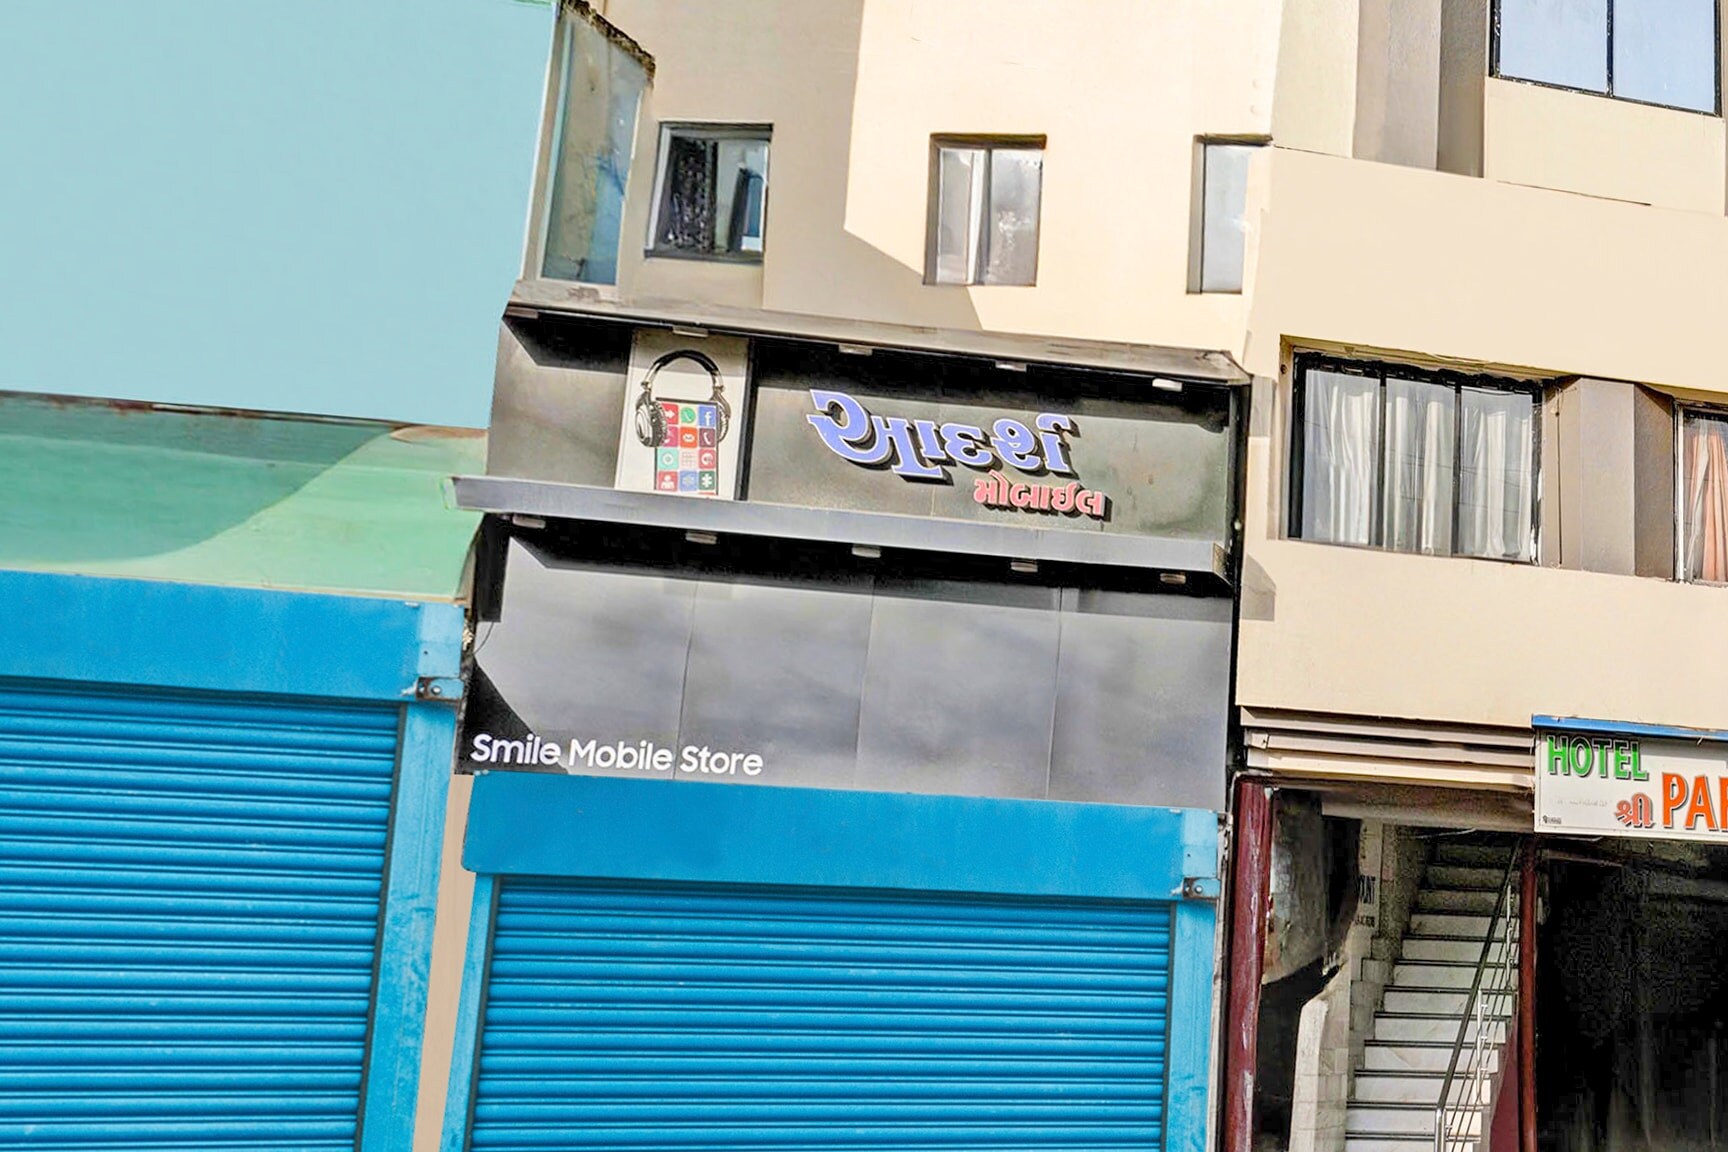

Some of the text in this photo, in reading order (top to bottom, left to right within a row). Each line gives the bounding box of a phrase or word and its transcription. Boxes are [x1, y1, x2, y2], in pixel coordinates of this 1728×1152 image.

[470, 733, 764, 777] Smile Mobile Store
[1546, 734, 1649, 781] HOTEL
